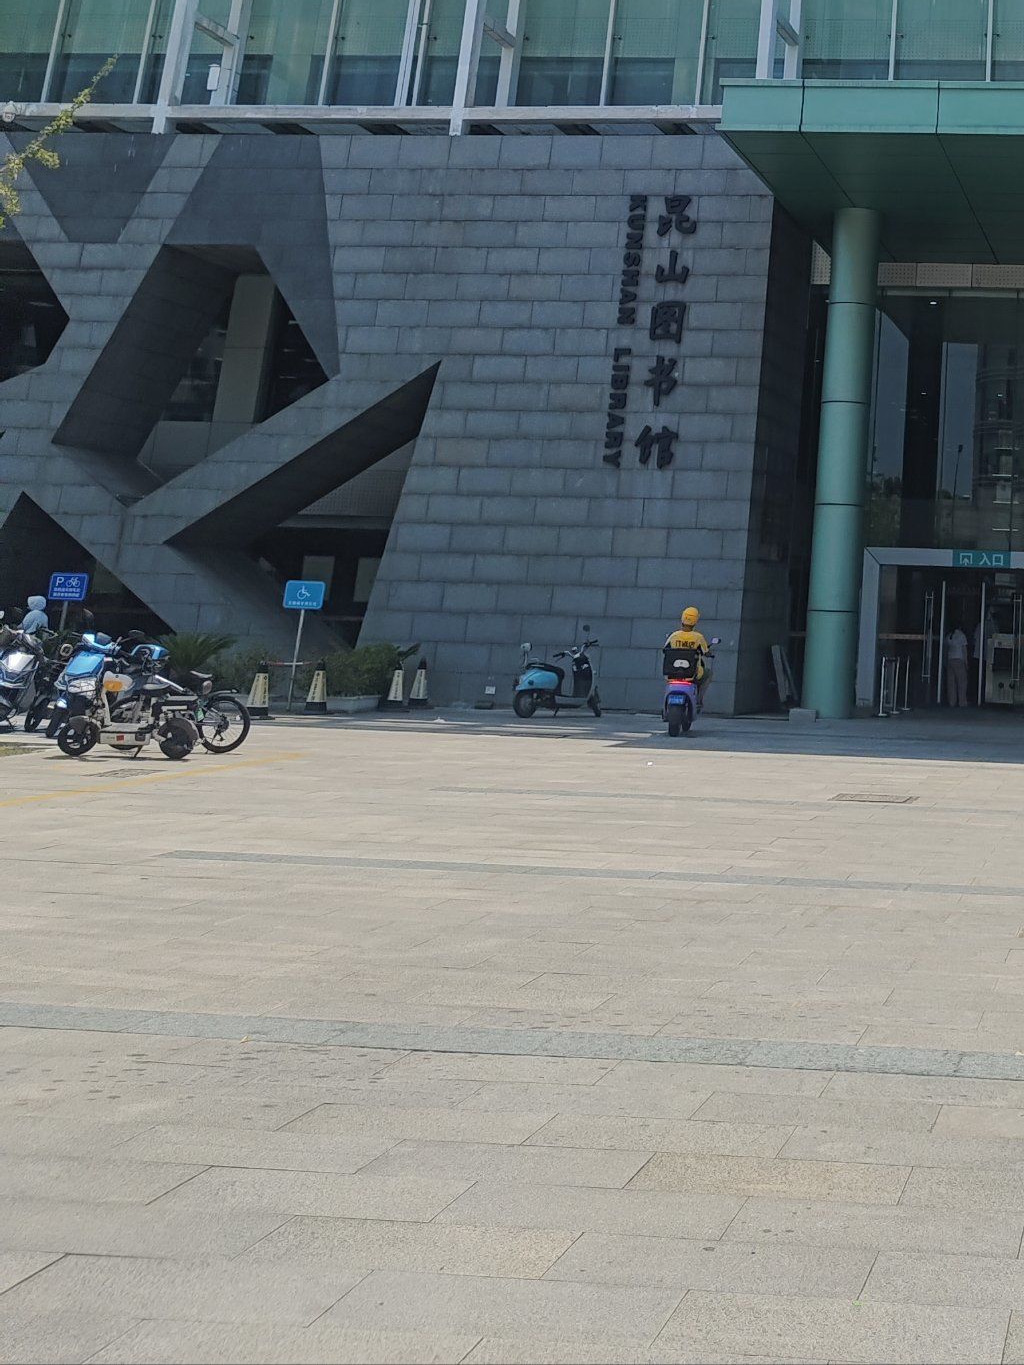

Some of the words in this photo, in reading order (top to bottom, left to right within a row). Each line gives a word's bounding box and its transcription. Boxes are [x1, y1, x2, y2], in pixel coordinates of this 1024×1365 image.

[616, 194, 647, 325] KUNSHAN
[635, 194, 697, 470] 昆山图书馆
[602, 347, 632, 468] LIBRARY
[55, 576, 65, 587] P
[979, 552, 1004, 566] 入口
